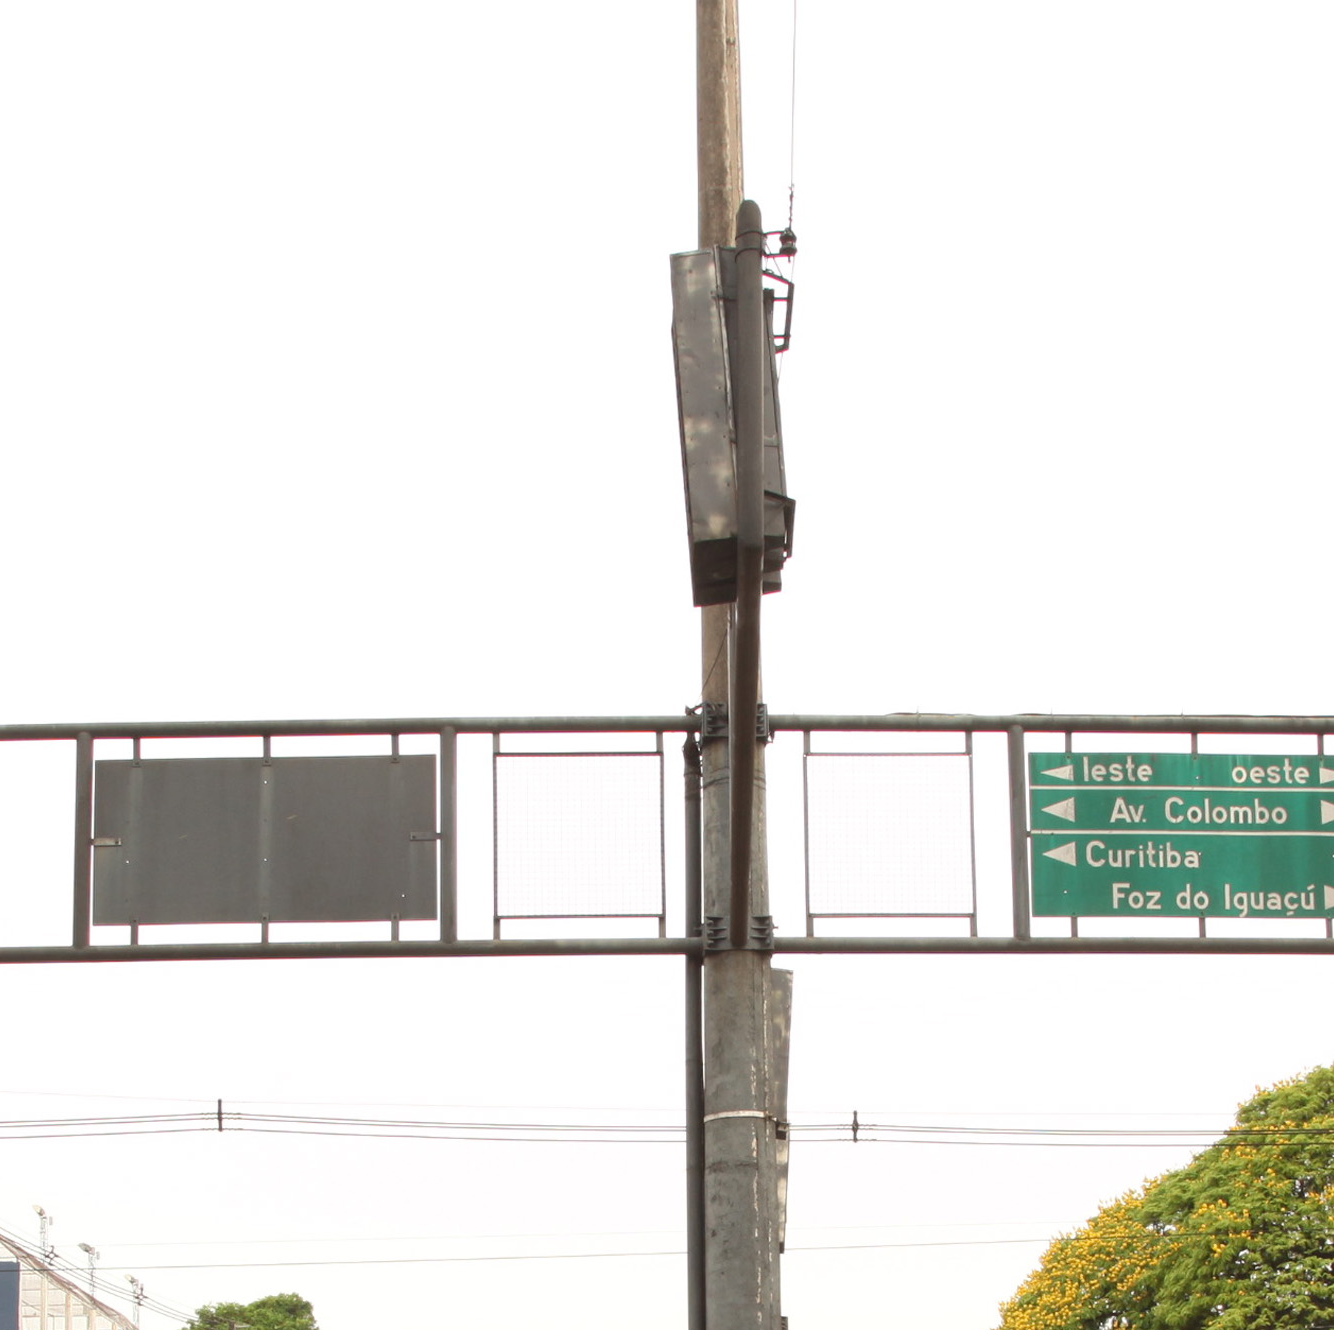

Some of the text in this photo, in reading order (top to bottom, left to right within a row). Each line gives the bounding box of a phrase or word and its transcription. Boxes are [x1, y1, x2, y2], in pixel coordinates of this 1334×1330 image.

[1082, 756, 1153, 782] leste
[1231, 758, 1310, 785] oeste
[1109, 796, 1288, 824] Av. Colombo
[1085, 840, 1200, 869] Curitiba
[1112, 883, 1316, 917] Foz do Iguaçú
